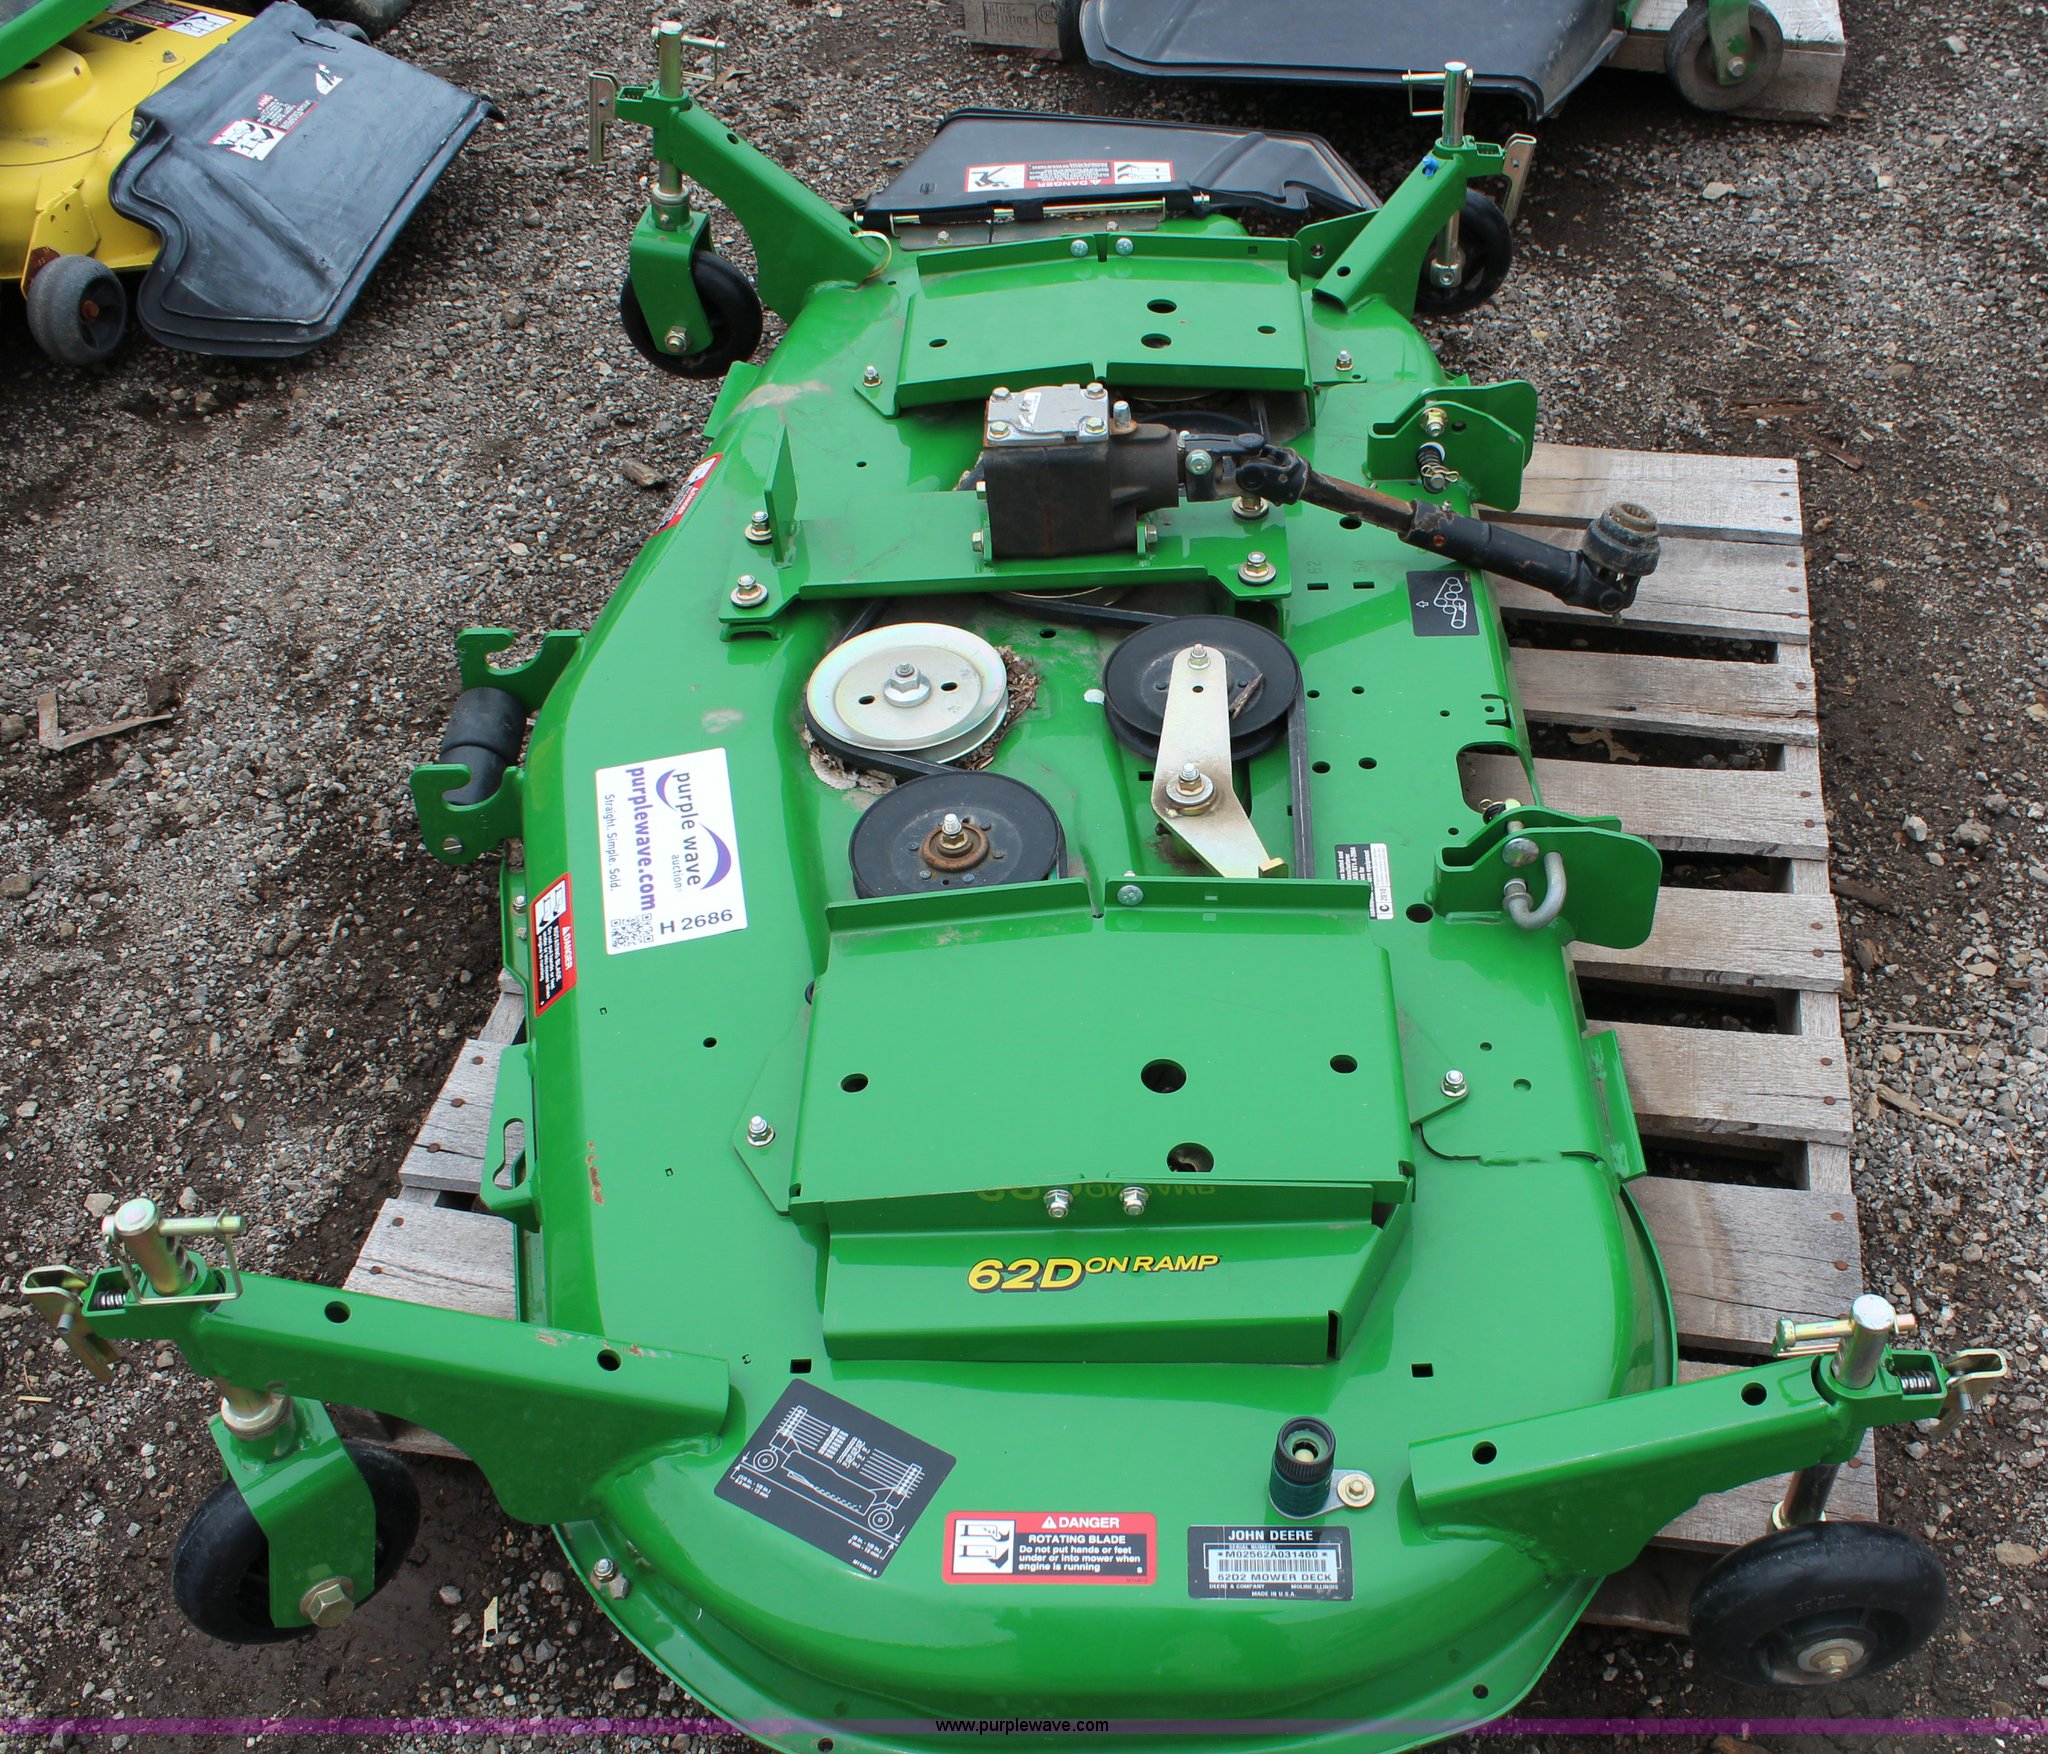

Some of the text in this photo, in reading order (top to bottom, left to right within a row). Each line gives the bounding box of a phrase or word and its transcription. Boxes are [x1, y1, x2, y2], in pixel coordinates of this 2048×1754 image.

[672, 772, 702, 886] purple wave
[603, 793, 621, 892] Straight. Simple. Sold.
[625, 766, 656, 911] purplewave.com
[672, 854, 682, 889] auction
[660, 909, 733, 935] H 2686
[967, 1254, 1220, 1293] 62D ON RAMP
[1058, 1516, 1120, 1529] DANGER
[1028, 1534, 1126, 1544] ROTATING BLADE
[1228, 1530, 1313, 1541] JOHN DEERE
[1019, 1545, 1033, 1554] Do
[1035, 1545, 1051, 1554] not
[1053, 1546, 1068, 1556] put
[1070, 1545, 1100, 1554] hands
[1113, 1545, 1132, 1554] feet
[1019, 1554, 1047, 1562] under
[1061, 1554, 1080, 1562] into
[1081, 1555, 1114, 1563] mower
[1115, 1554, 1141, 1563] when
[1018, 1563, 1101, 1573] engine is running
[1217, 1573, 1332, 1581] 62D2 MOWER DECK
